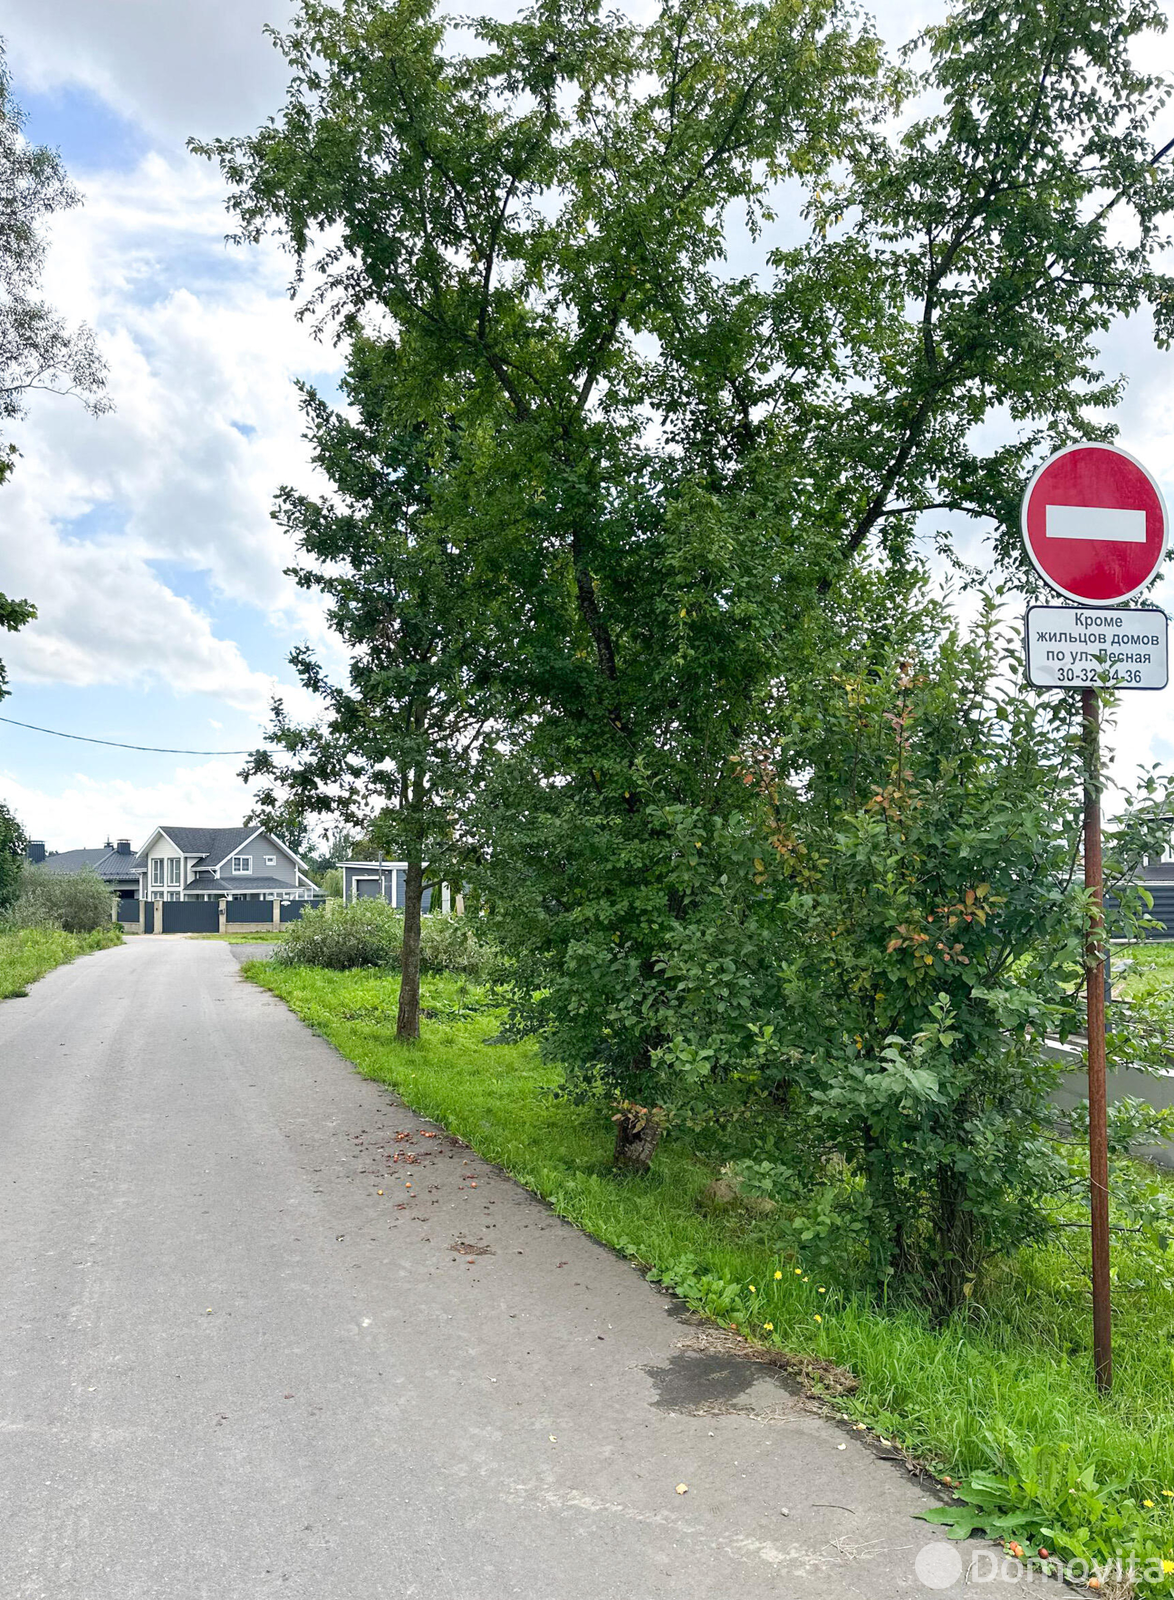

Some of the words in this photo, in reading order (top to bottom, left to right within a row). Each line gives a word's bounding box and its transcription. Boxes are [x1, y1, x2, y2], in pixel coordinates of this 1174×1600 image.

[1075, 612, 1123, 629] Кроме
[1036, 631, 1107, 645] жильцов
[1111, 633, 1160, 646] домов
[1046, 650, 1065, 661] по
[1070, 650, 1093, 664] ул.
[1057, 668, 1142, 683] 30-3234-36
